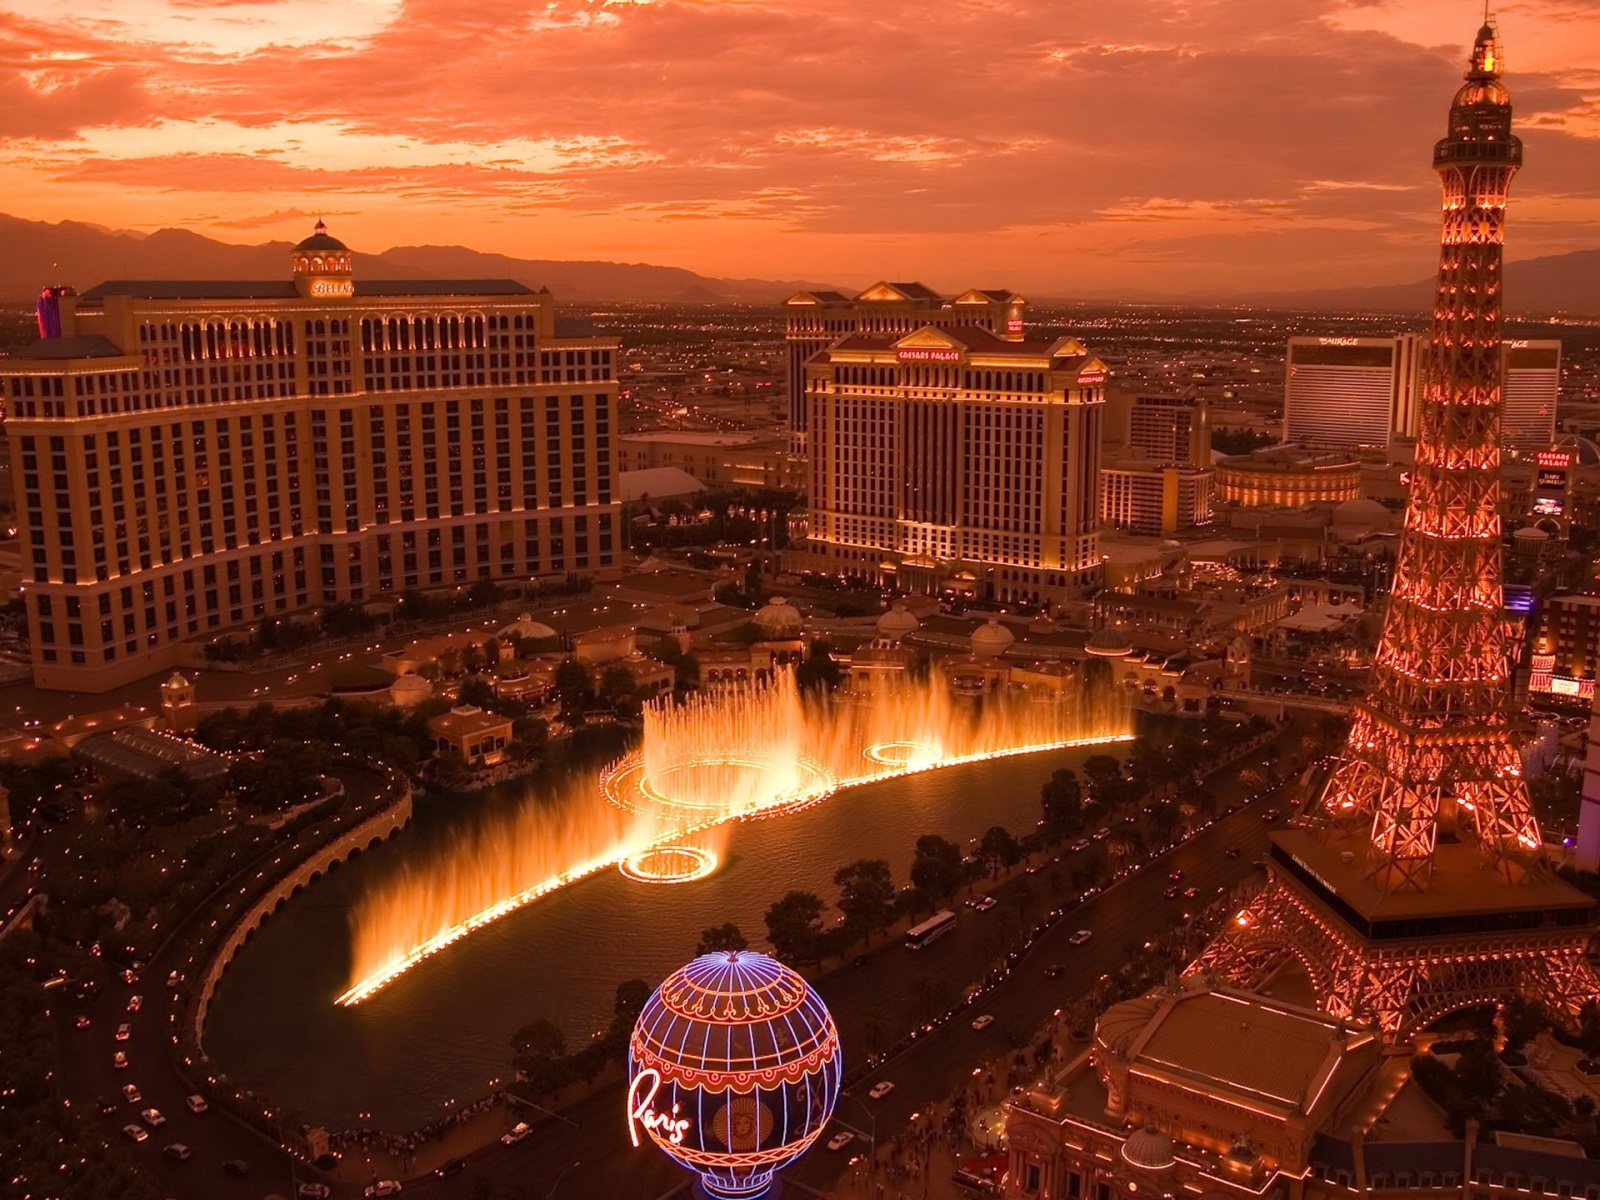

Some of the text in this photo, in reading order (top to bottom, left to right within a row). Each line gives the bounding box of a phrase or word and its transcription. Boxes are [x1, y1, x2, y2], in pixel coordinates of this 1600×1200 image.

[1321, 337, 1359, 346] MIRAGE
[899, 351, 959, 361] CAESARS PALACE
[1538, 452, 1570, 461] CAESARS
[1539, 459, 1568, 467] PALACE
[627, 1068, 690, 1147] Paris
